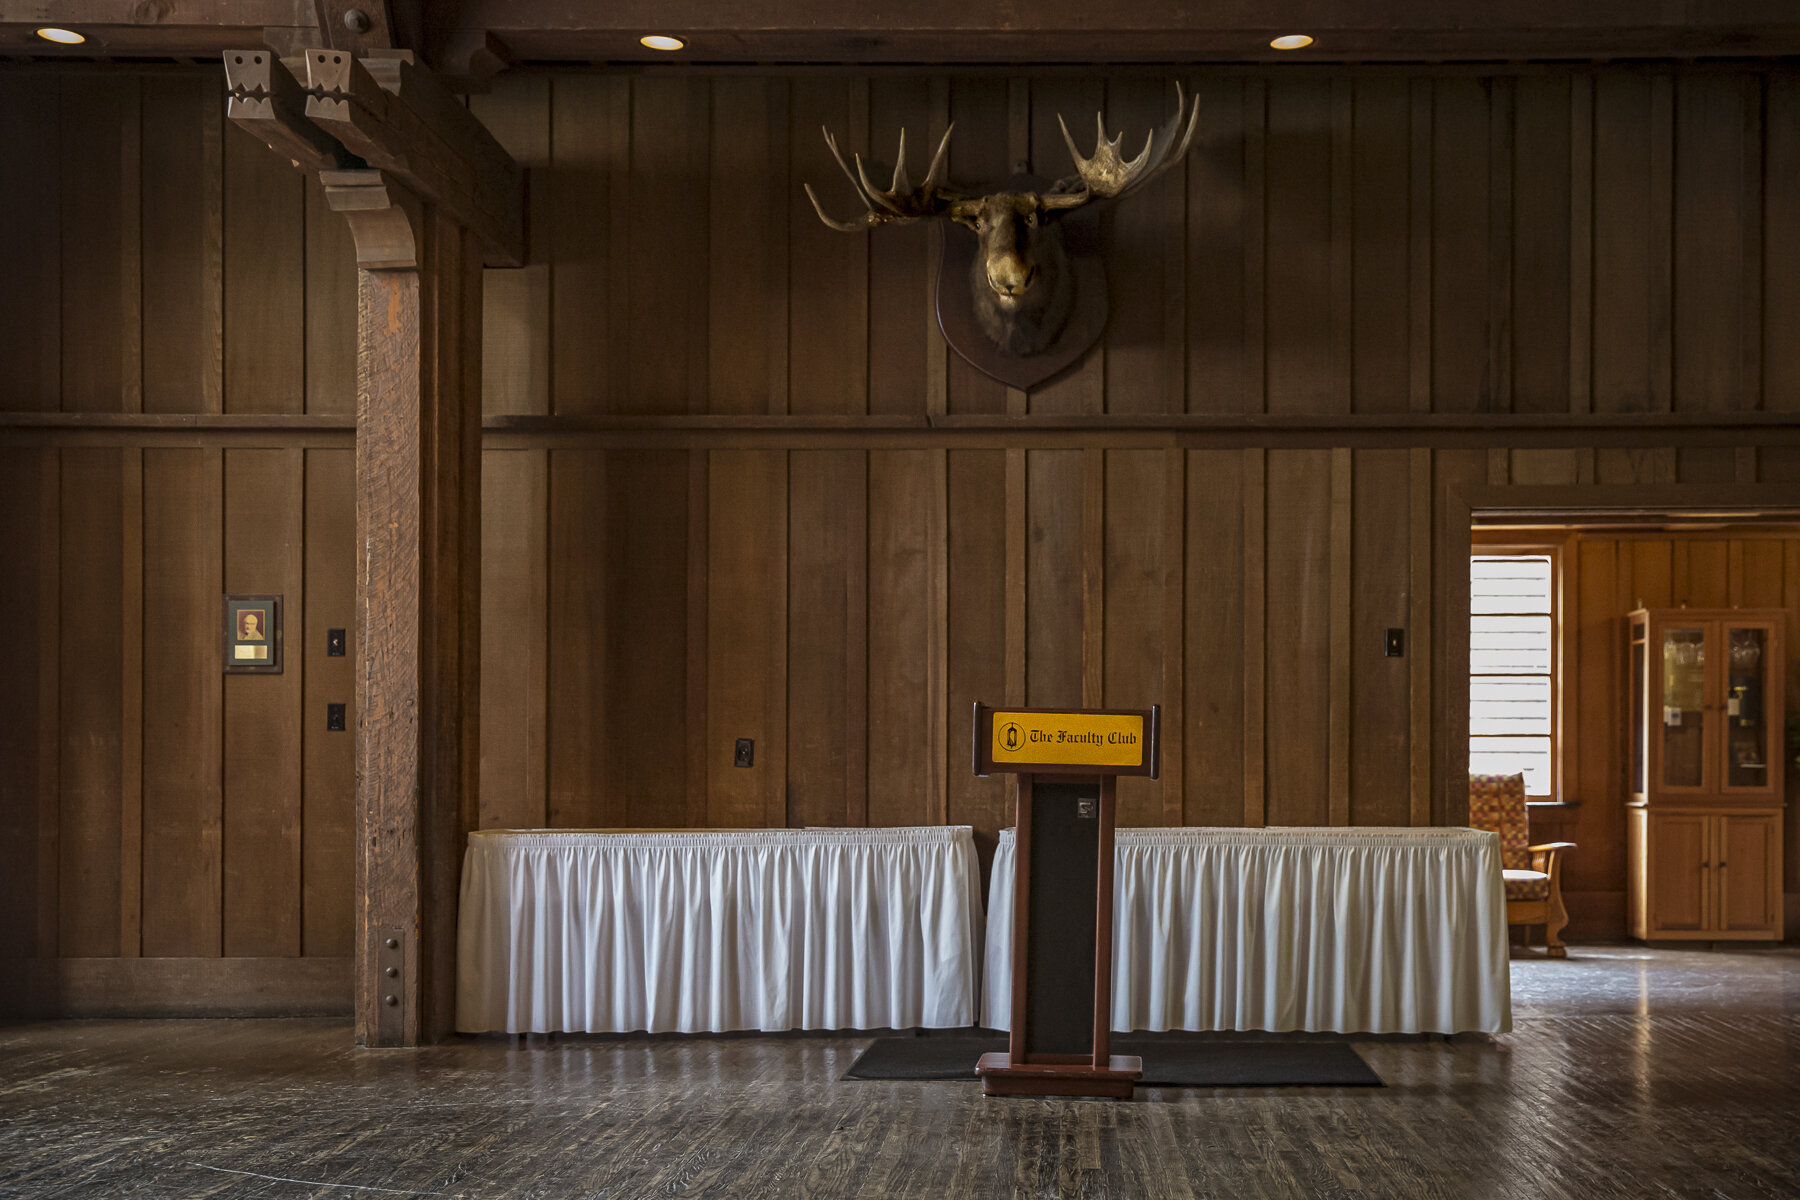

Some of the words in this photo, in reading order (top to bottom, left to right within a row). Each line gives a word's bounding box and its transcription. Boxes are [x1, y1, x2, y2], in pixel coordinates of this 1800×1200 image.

[1030, 730, 1053, 743] The
[1056, 730, 1103, 747] Faculty
[1107, 732, 1137, 745] Club
